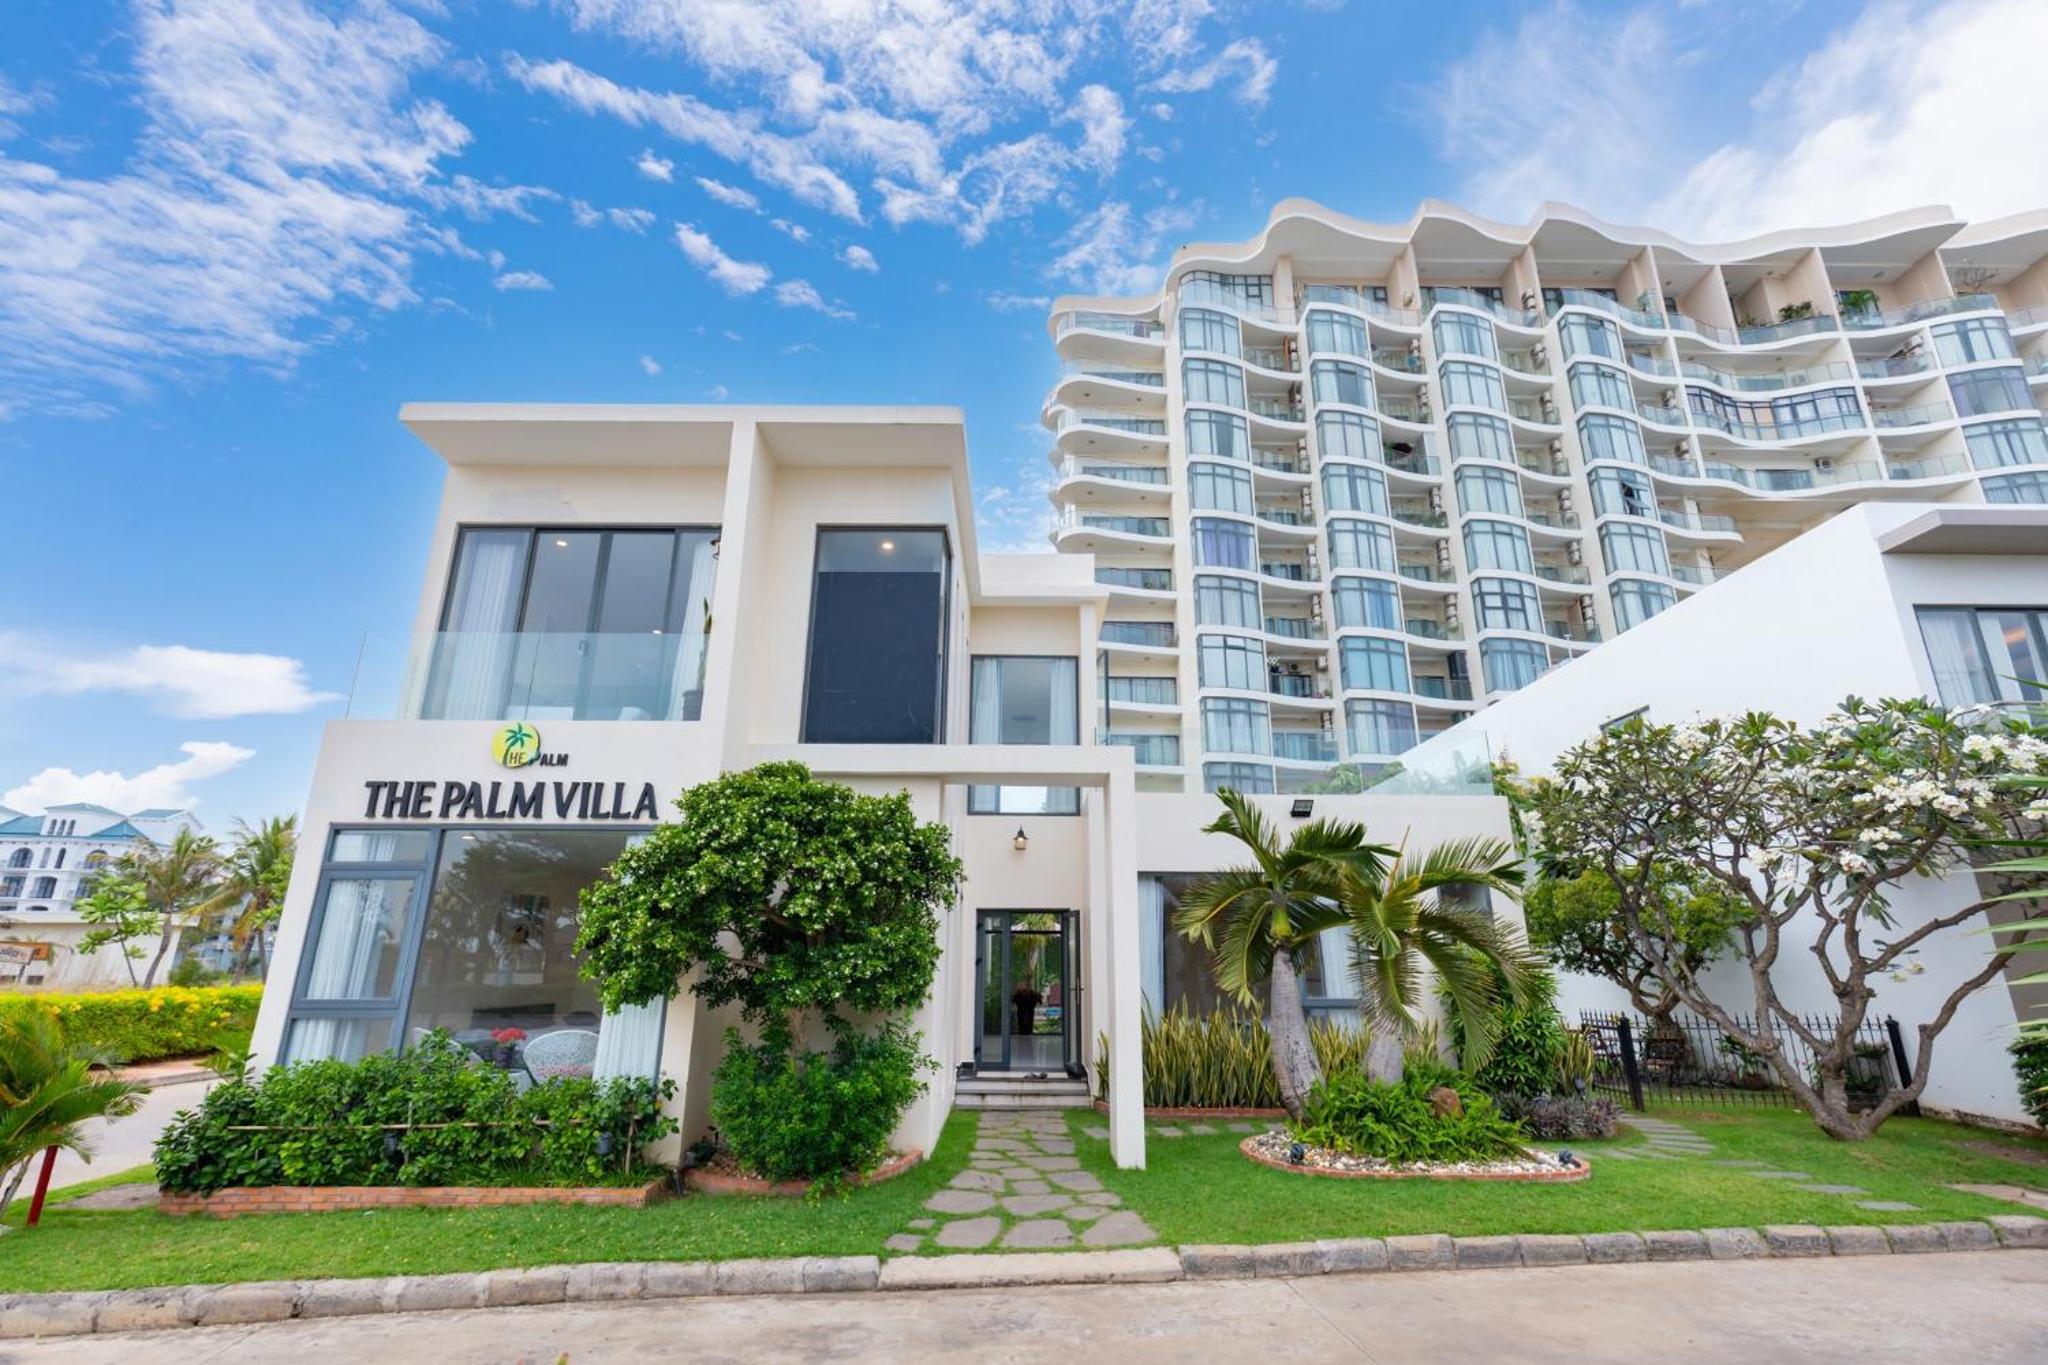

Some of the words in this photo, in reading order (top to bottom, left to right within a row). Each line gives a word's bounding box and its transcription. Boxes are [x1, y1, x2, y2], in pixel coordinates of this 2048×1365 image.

[364, 780, 436, 819] THE
[438, 780, 546, 819] PALM
[553, 780, 659, 820] VILLA
